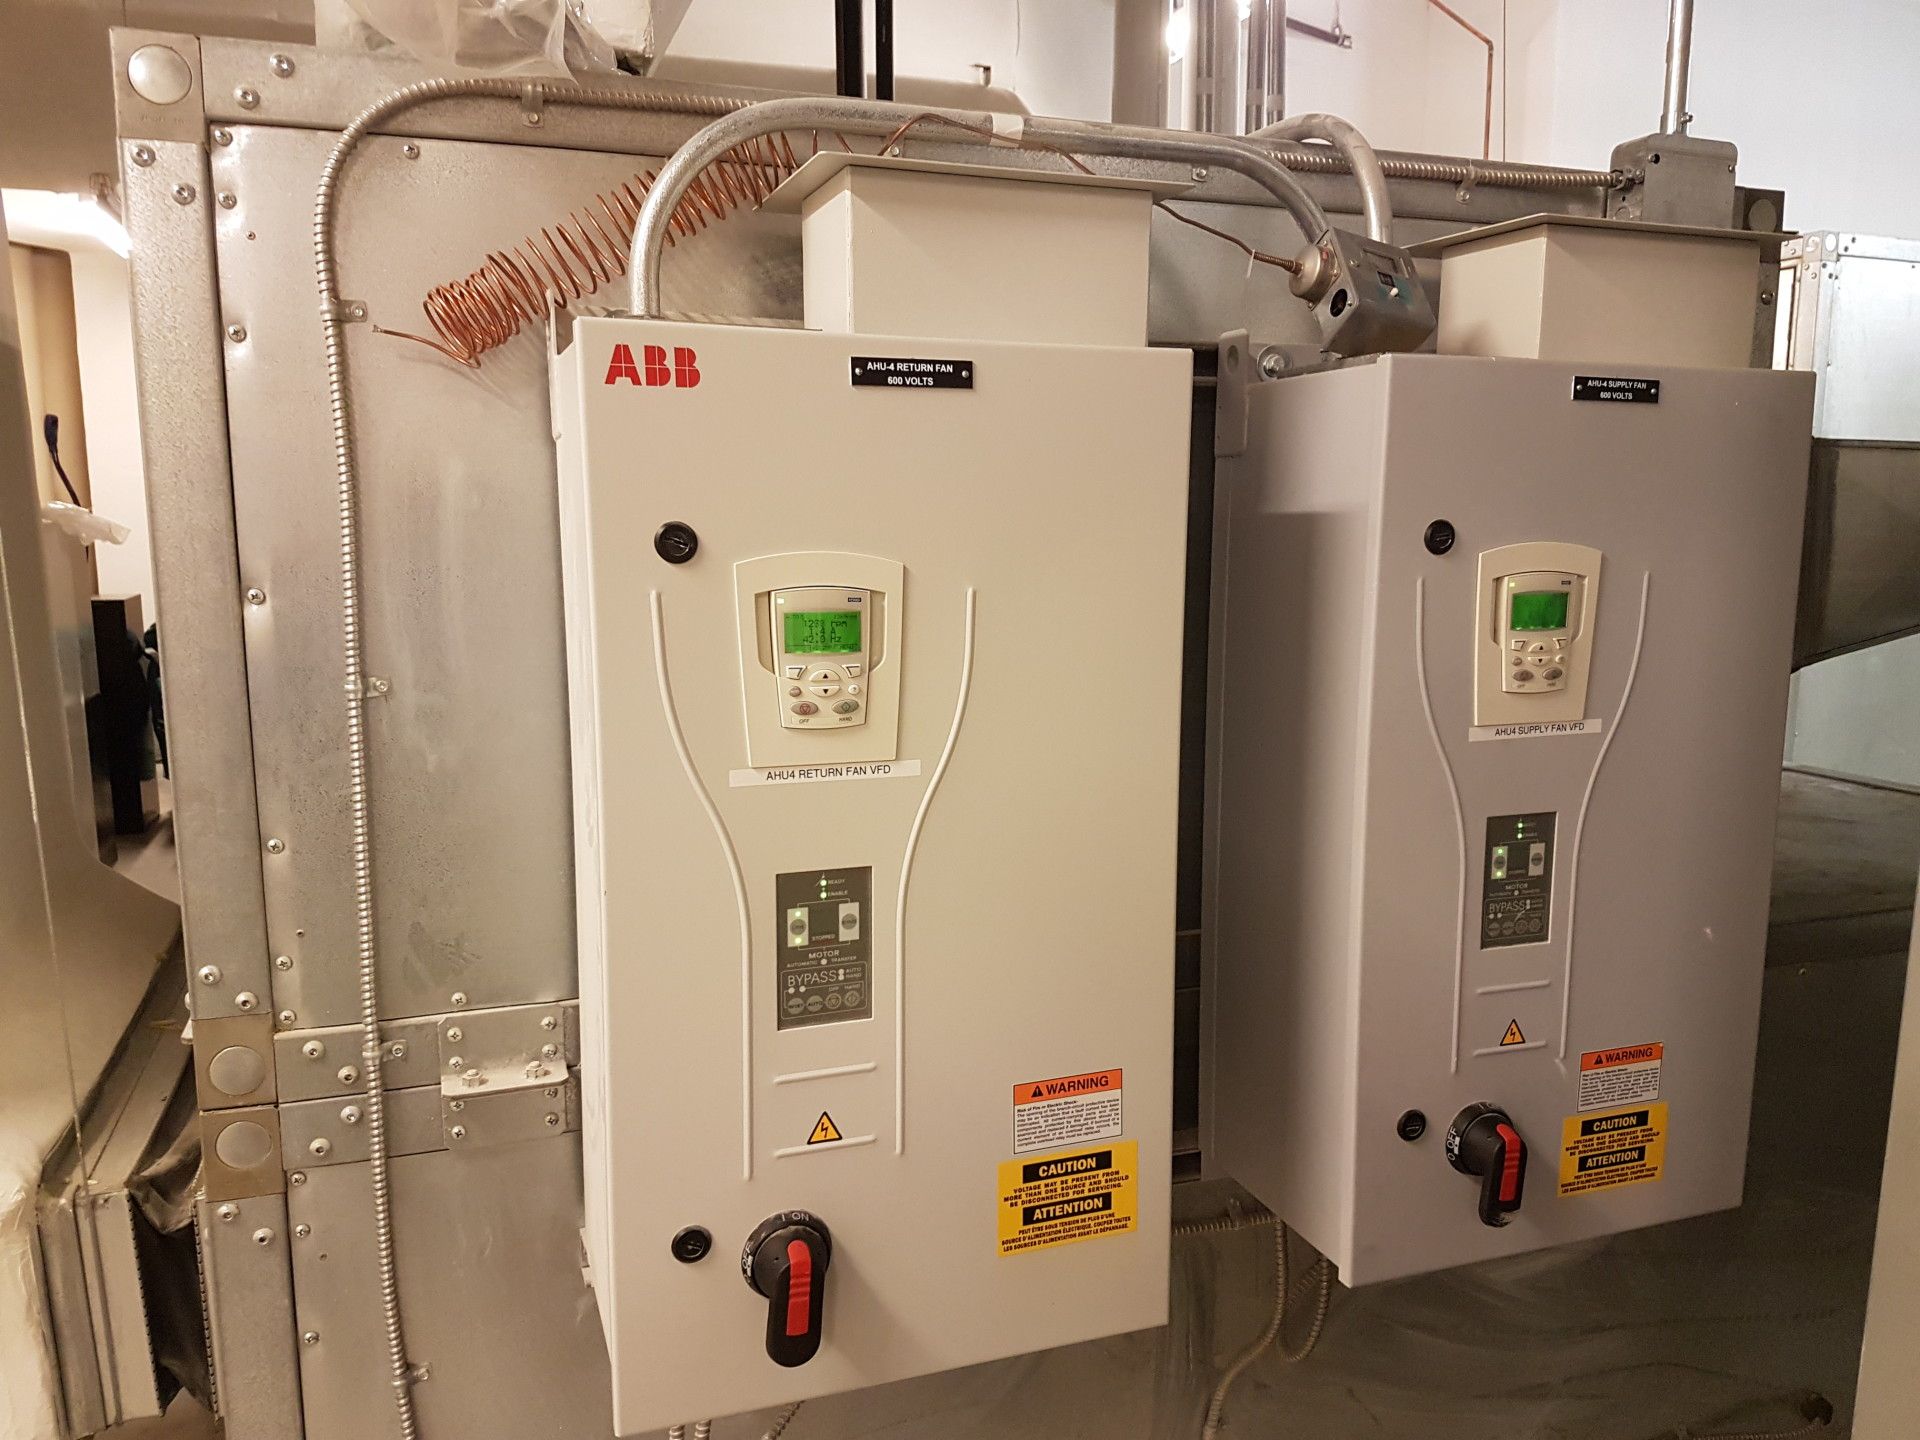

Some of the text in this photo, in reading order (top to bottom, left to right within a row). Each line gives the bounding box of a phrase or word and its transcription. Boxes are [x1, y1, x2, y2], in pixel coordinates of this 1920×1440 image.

[604, 344, 700, 388] ABB
[866, 362, 954, 373] AHU-4 RETURN FAN
[888, 376, 934, 386] 600 VOLTS
[1608, 380, 1633, 388] SUPPLY
[1494, 728, 1516, 736] AHU4
[1518, 725, 1549, 735] SUPPLY
[1569, 723, 1585, 731] VFD
[766, 764, 891, 781] AHU4 RETURN FAN VFD
[1490, 900, 1525, 913] BYPASS
[808, 950, 840, 959] MOTOR
[788, 970, 837, 987] BYPASS
[1605, 1047, 1653, 1063] WARNING
[1046, 1075, 1109, 1095] WARNING
[1593, 1116, 1637, 1131] CAUTION
[1446, 1126, 1458, 1148] OFF
[1039, 1157, 1096, 1177] CAUTION
[1586, 1150, 1639, 1168] ATTENTION
[1013, 1184, 1041, 1194] VOLTAGE
[1071, 1173, 1098, 1183] PRESENT
[1060, 1182, 1085, 1191] SOURCE
[1104, 1174, 1128, 1183] SHOULD
[1021, 1191, 1069, 1205] DISCONNECTED
[792, 1212, 809, 1221] ON
[1033, 1197, 1103, 1220] ATTENTION
